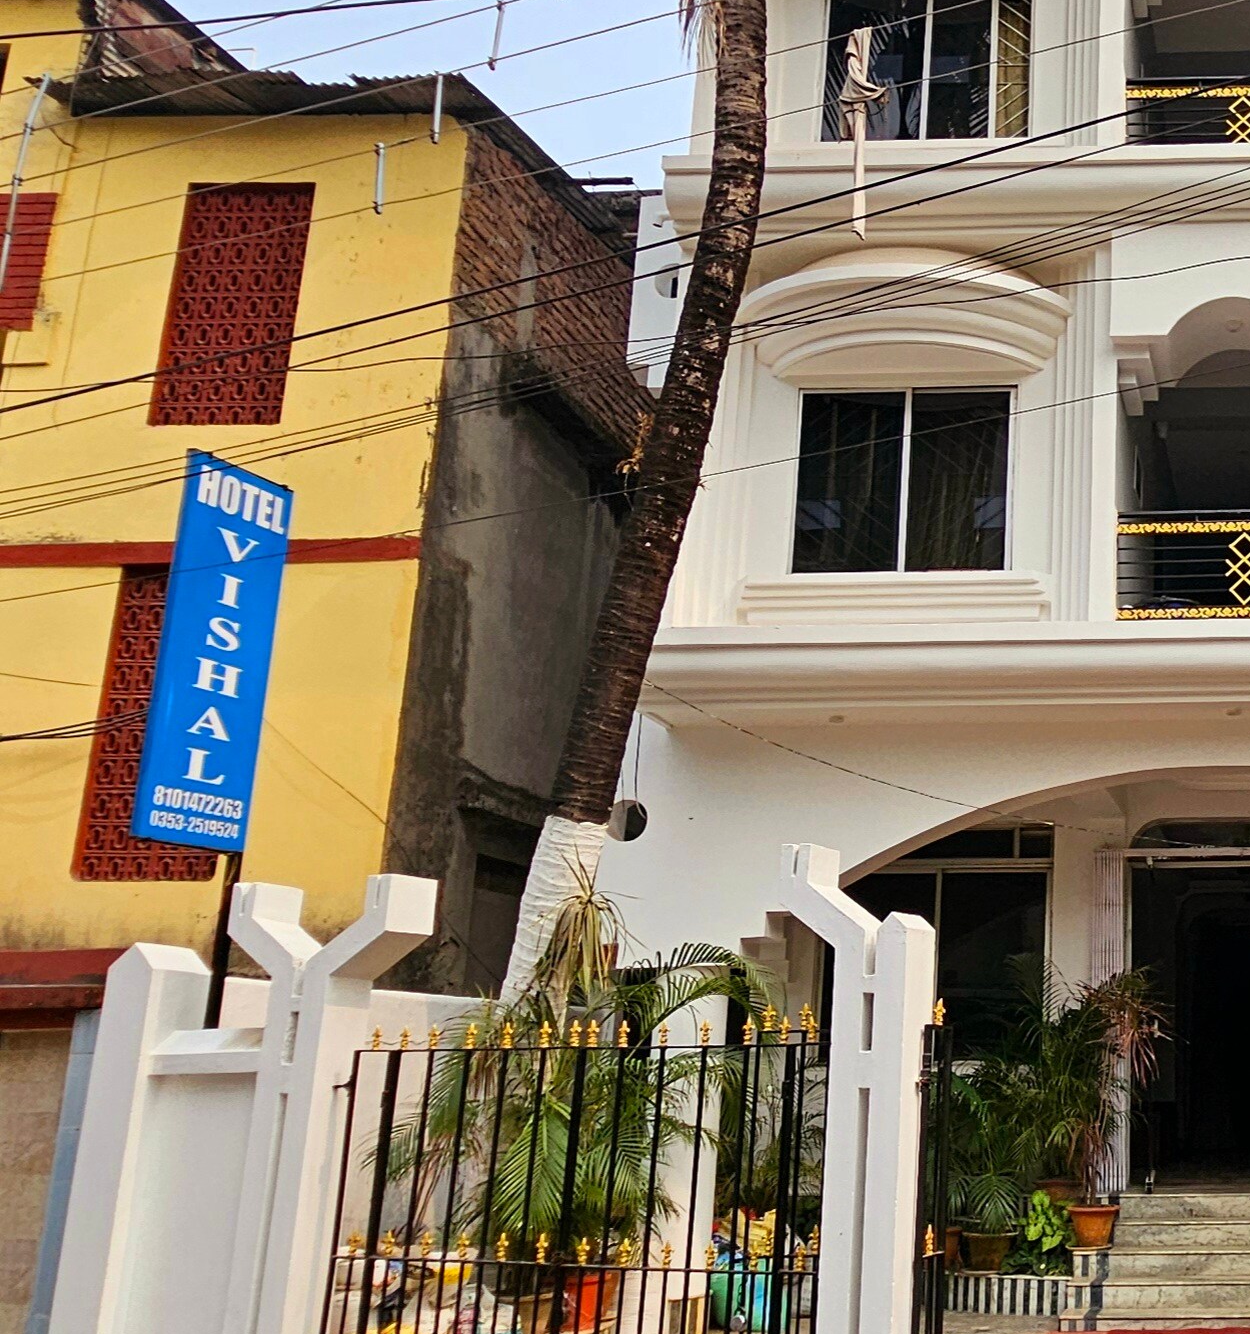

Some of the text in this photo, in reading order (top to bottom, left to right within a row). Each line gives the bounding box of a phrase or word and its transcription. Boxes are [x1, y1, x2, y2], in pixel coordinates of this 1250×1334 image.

[197, 464, 285, 535] HOTEL
[181, 526, 261, 786] VISHAL
[149, 809, 241, 840] 0353-2519524
[152, 784, 244, 819] 8101472263
